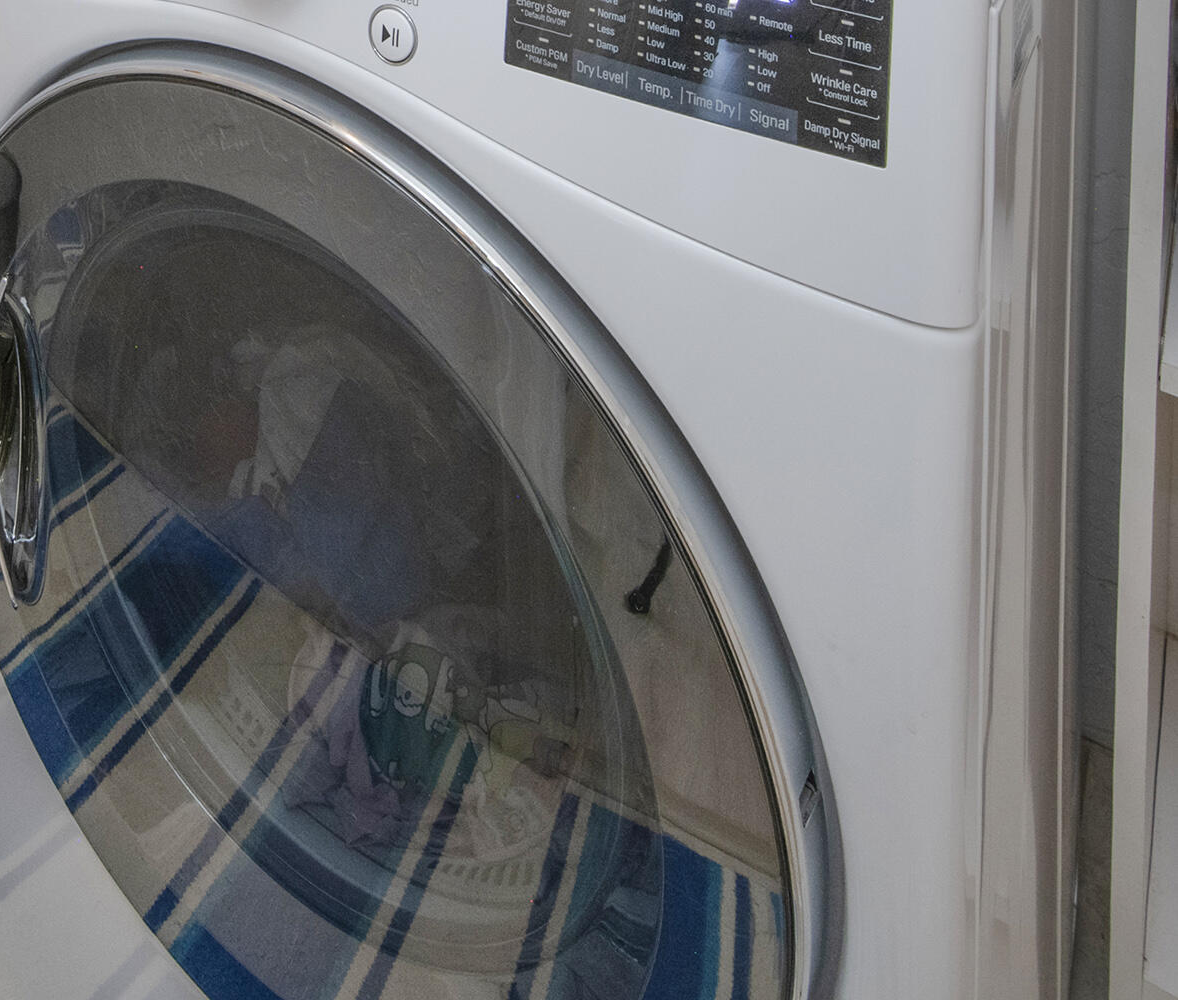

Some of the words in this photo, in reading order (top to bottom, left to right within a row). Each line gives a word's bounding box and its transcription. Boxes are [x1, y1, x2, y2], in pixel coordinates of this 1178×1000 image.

[524, 10, 546, 21] Default
[546, 3, 571, 18] Saver
[597, 8, 626, 23] Normal
[647, 5, 664, 16] Mid
[664, 9, 684, 22] High
[705, 3, 716, 13] 60
[717, 7, 733, 17] min
[596, 23, 615, 36] Less
[647, 20, 680, 37] Medium
[704, 19, 716, 30] 50
[758, 15, 794, 33] Remote
[596, 39, 619, 54] Damp
[646, 36, 665, 49] Low
[703, 36, 715, 46] 40
[818, 29, 844, 46] Less
[844, 35, 872, 53] Time
[516, 40, 547, 56] Custom
[548, 48, 568, 63] PGM
[703, 51, 714, 62] 30
[757, 48, 779, 62] High
[645, 51, 666, 66] Ultra
[667, 57, 686, 71] Low
[576, 60, 595, 78] Dry
[595, 66, 624, 85] Level
[702, 67, 714, 78] 20
[757, 65, 778, 79] Low
[637, 77, 674, 100] Temp.
[756, 81, 771, 93] Off
[810, 71, 852, 93] Wrinkle
[852, 83, 878, 99] Care
[685, 90, 713, 110] Time
[714, 99, 736, 118] Dry
[822, 88, 850, 103] Control
[850, 95, 869, 107] Lock
[749, 109, 790, 131] Signal
[804, 119, 831, 137] Damp
[832, 126, 850, 142] Dry
[850, 132, 881, 150] Signal
[833, 140, 855, 153] Wi-Fi
